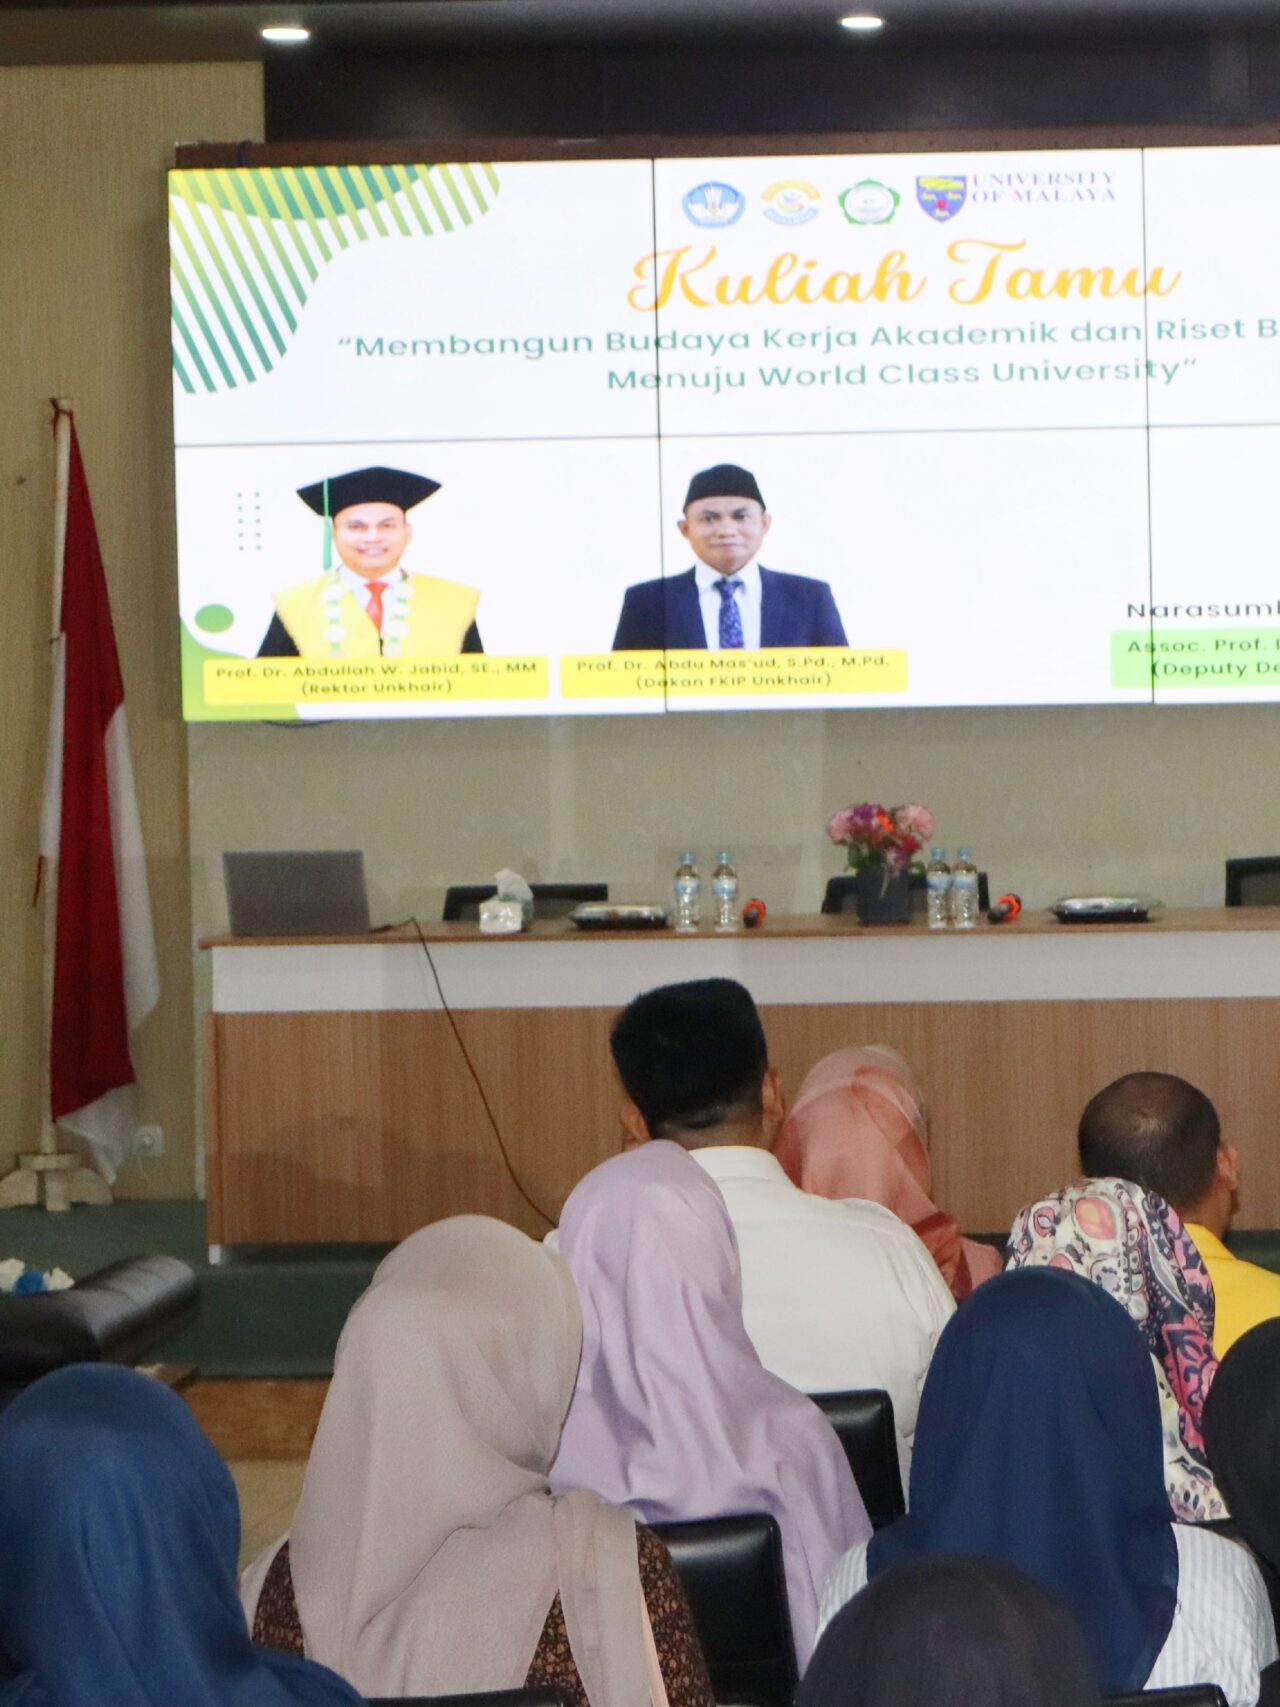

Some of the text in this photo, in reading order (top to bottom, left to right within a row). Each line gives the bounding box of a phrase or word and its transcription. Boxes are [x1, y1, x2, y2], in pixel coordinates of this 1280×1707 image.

[973, 171, 1116, 186] UNIVERSITY
[972, 187, 1117, 202] OF MALAYA
[627, 239, 1182, 312] Kuliah Tamu
[606, 330, 750, 357] Budaya
[763, 326, 857, 353] Kerja
[871, 321, 1057, 346] Akademik
[1070, 321, 1142, 343] dan
[1157, 318, 1246, 341] Riset
[608, 368, 745, 394] Menuju
[759, 364, 867, 387] World
[879, 363, 980, 384] Class
[1128, 640, 1206, 653] Assoc.
[1215, 638, 1267, 651] Prof.
[217, 667, 254, 678] Prof.
[263, 666, 285, 677] Dr.
[293, 664, 374, 677] Abdullah
[381, 666, 403, 676] W.
[410, 663, 464, 675] Jabid,
[506, 663, 537, 673] MM
[577, 660, 617, 671] Prof.
[625, 660, 647, 671] Dr.
[655, 658, 704, 671] Abdu
[842, 655, 889, 666] M.Pd.
[1151, 660, 1248, 678] (Deputy
[301, 681, 452, 696] (Rektor Unkhair)
[636, 673, 832, 689] (Dekan FKIP Unkhair)
